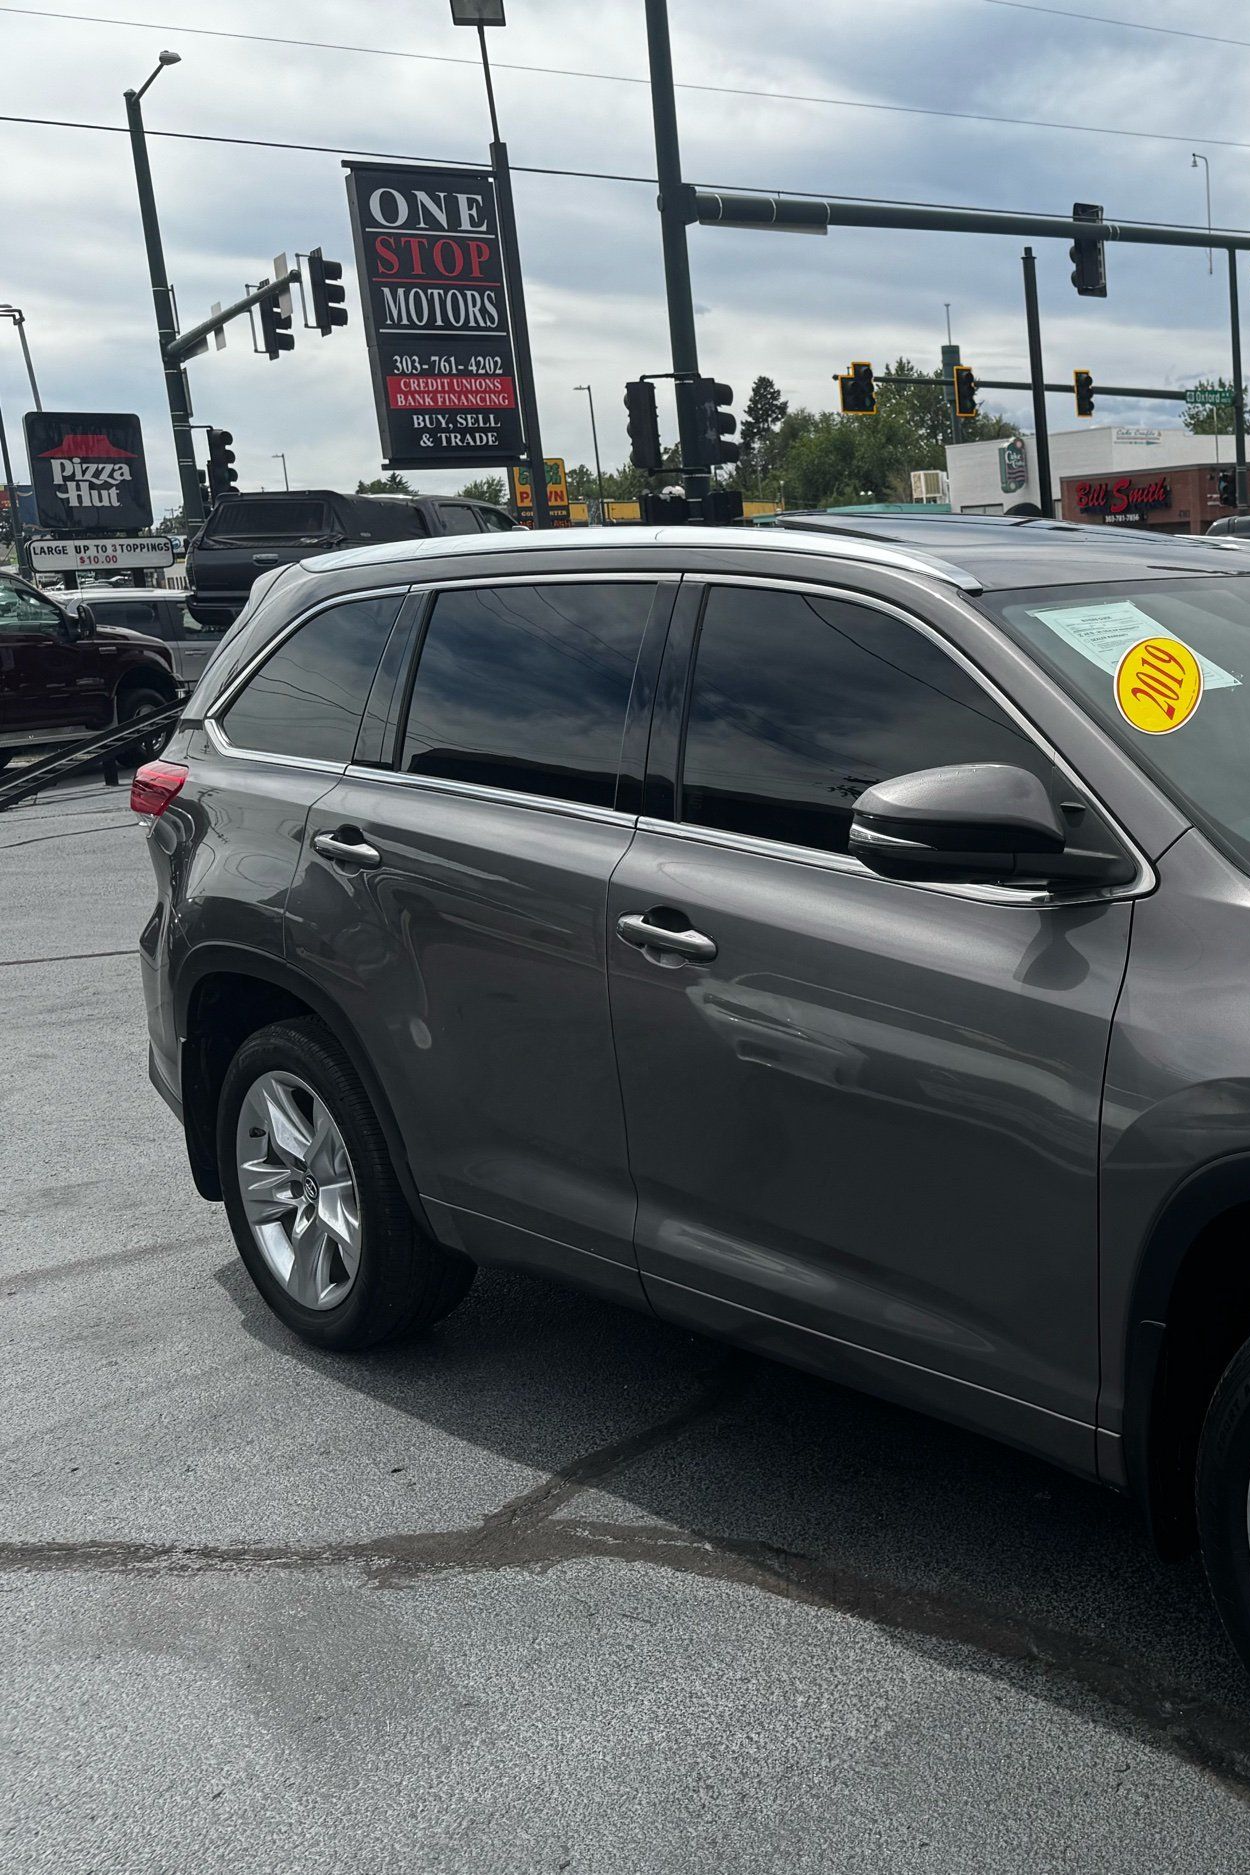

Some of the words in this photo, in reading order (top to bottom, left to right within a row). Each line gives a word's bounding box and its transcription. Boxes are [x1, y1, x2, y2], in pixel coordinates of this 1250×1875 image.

[369, 187, 488, 232] ONE
[375, 235, 490, 277] STOP
[381, 287, 499, 328] MOTORS
[393, 355, 503, 374] 303-761-4202
[400, 378, 450, 392] CREDIT
[453, 378, 501, 392] UNIONS
[397, 393, 434, 406] BANK
[437, 393, 508, 406] FINANCING
[413, 414, 453, 430] BUY,
[456, 414, 501, 428] SELL
[420, 433, 434, 447] &
[437, 433, 499, 446] TRADE
[50, 457, 132, 485] Pizza
[56, 481, 121, 507] Hut
[1076, 481, 1106, 508] Bill
[1111, 477, 1166, 513] Smith
[33, 545, 69, 556] LARGE
[75, 544, 90, 555] UP
[94, 544, 108, 554] TO
[111, 543, 118, 553] 3
[119, 542, 170, 553] TOPPINGS
[79, 555, 118, 565] $10.00
[1131, 645, 1186, 721] 2019
